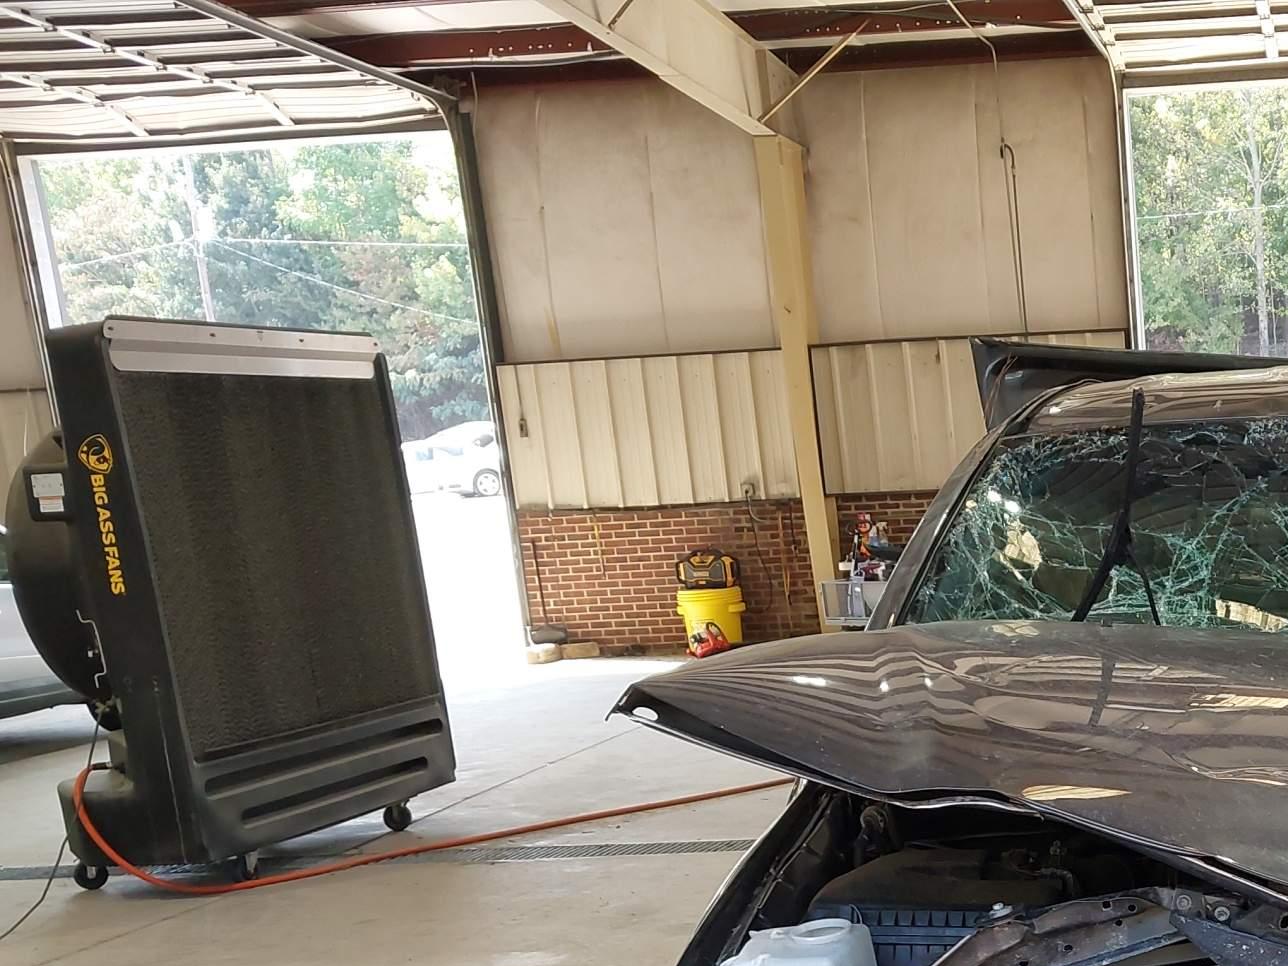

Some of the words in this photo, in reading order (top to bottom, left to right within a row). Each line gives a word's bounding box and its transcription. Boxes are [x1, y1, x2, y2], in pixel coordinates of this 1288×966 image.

[91, 474, 109, 505] BIG
[97, 507, 116, 545] ASS
[104, 546, 126, 596] FANS
